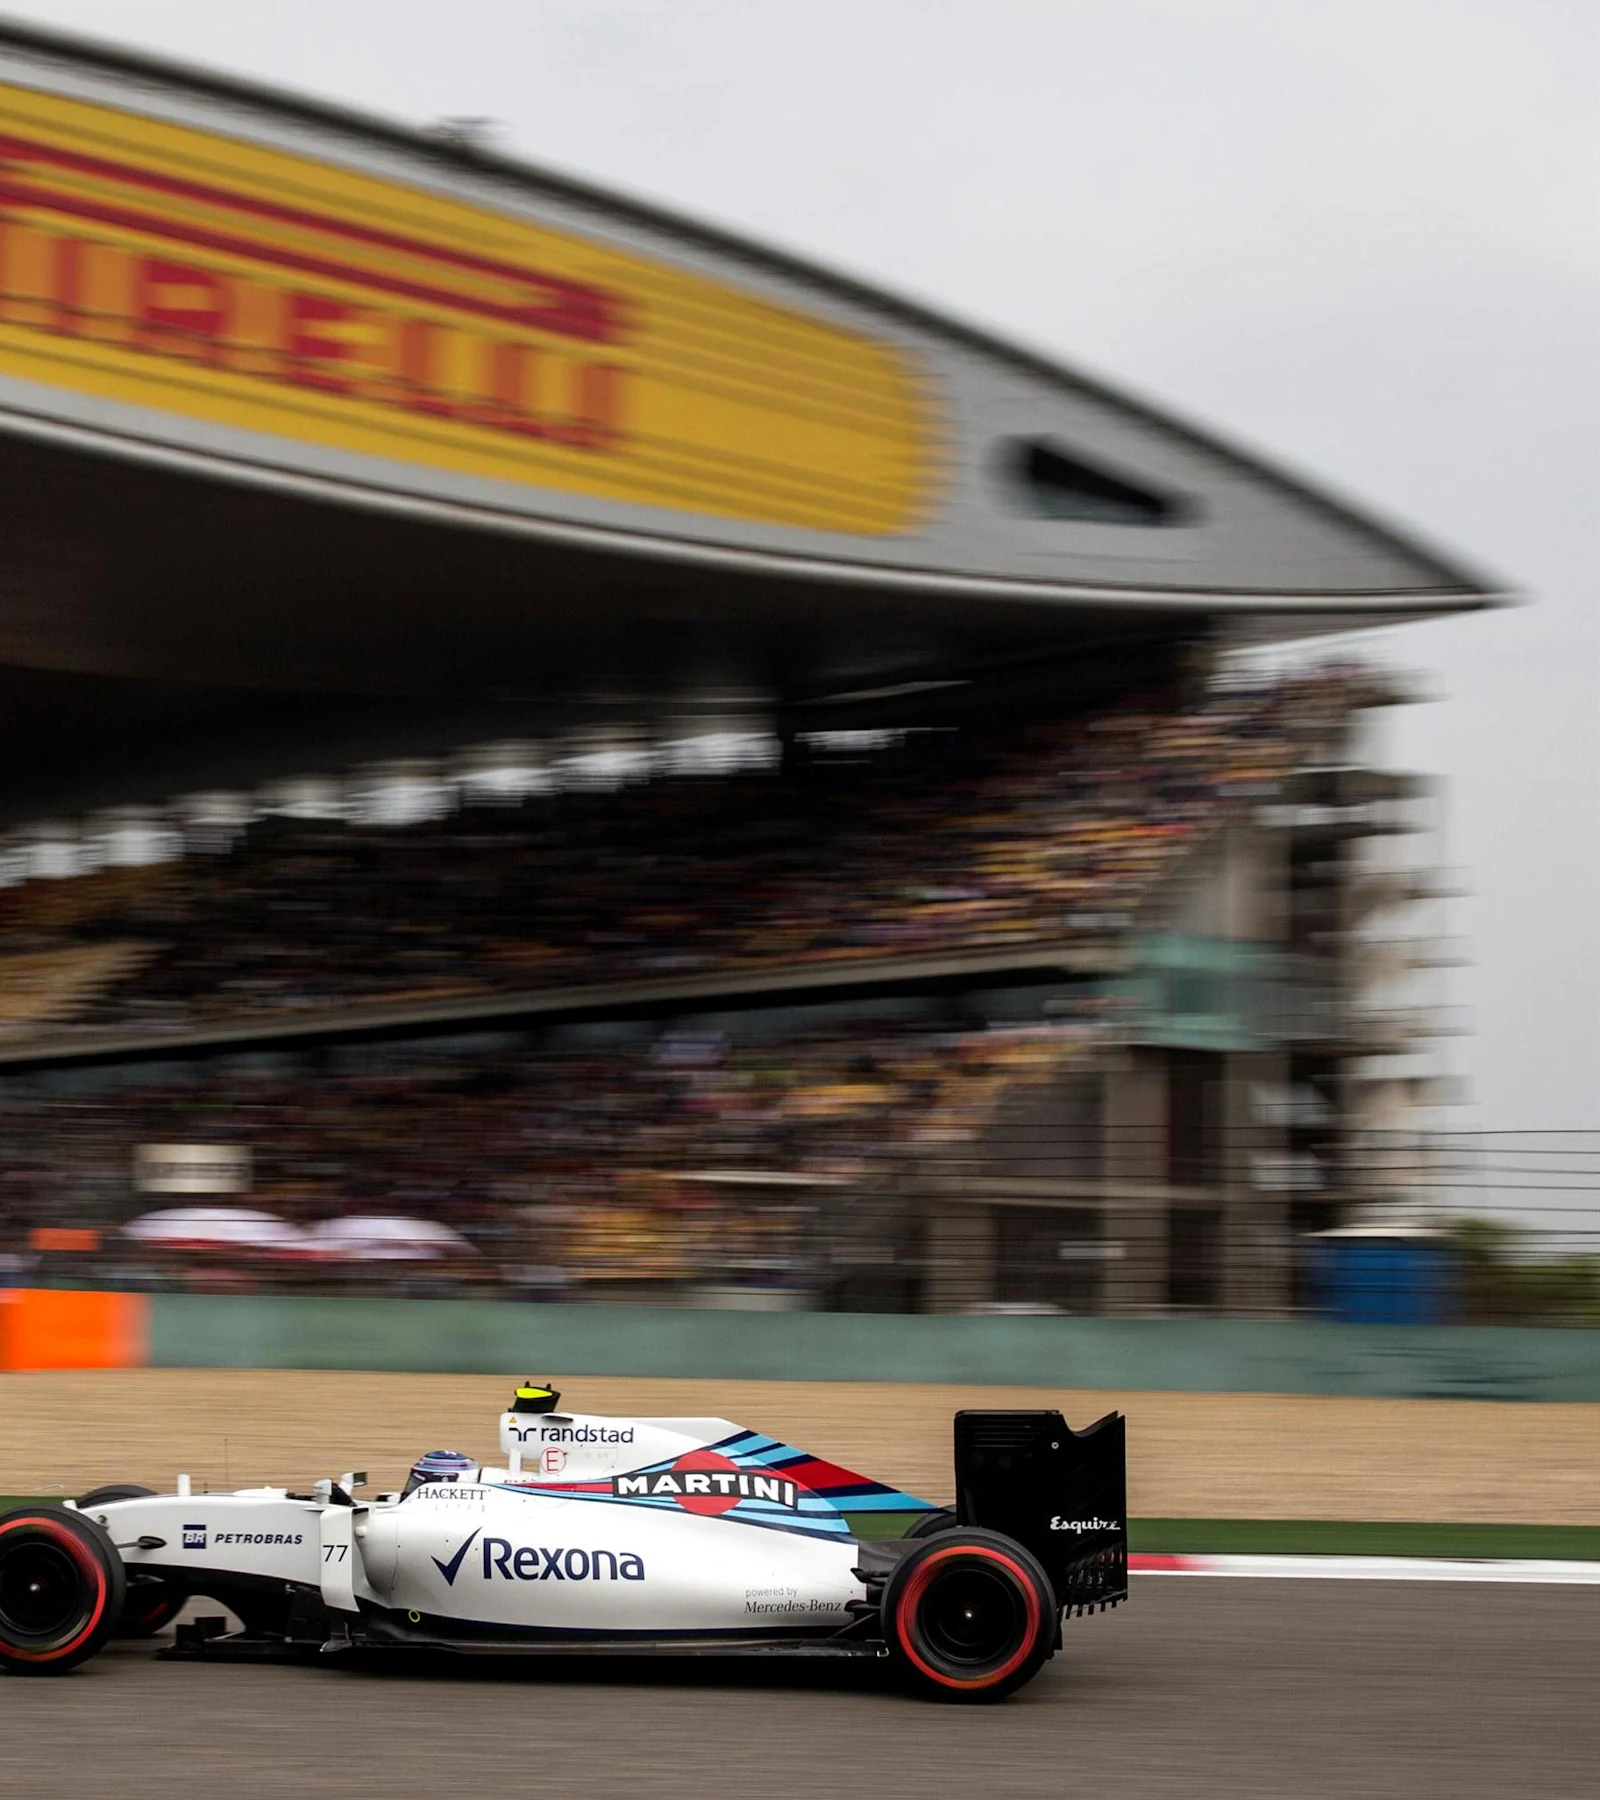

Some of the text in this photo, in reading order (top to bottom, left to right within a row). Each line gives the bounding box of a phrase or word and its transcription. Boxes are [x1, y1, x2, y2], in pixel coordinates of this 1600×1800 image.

[541, 1424, 634, 1443] randstad
[417, 1487, 487, 1500] HACKETT
[618, 1473, 796, 1506] MARTINI
[1049, 1515, 1121, 1535] Esquire
[214, 1533, 304, 1545] PETROBRAS
[322, 1544, 349, 1563] 77
[483, 1537, 645, 1581] Rexona
[745, 1587, 798, 1599] powered by
[744, 1599, 842, 1614] Mercedes-Benz
